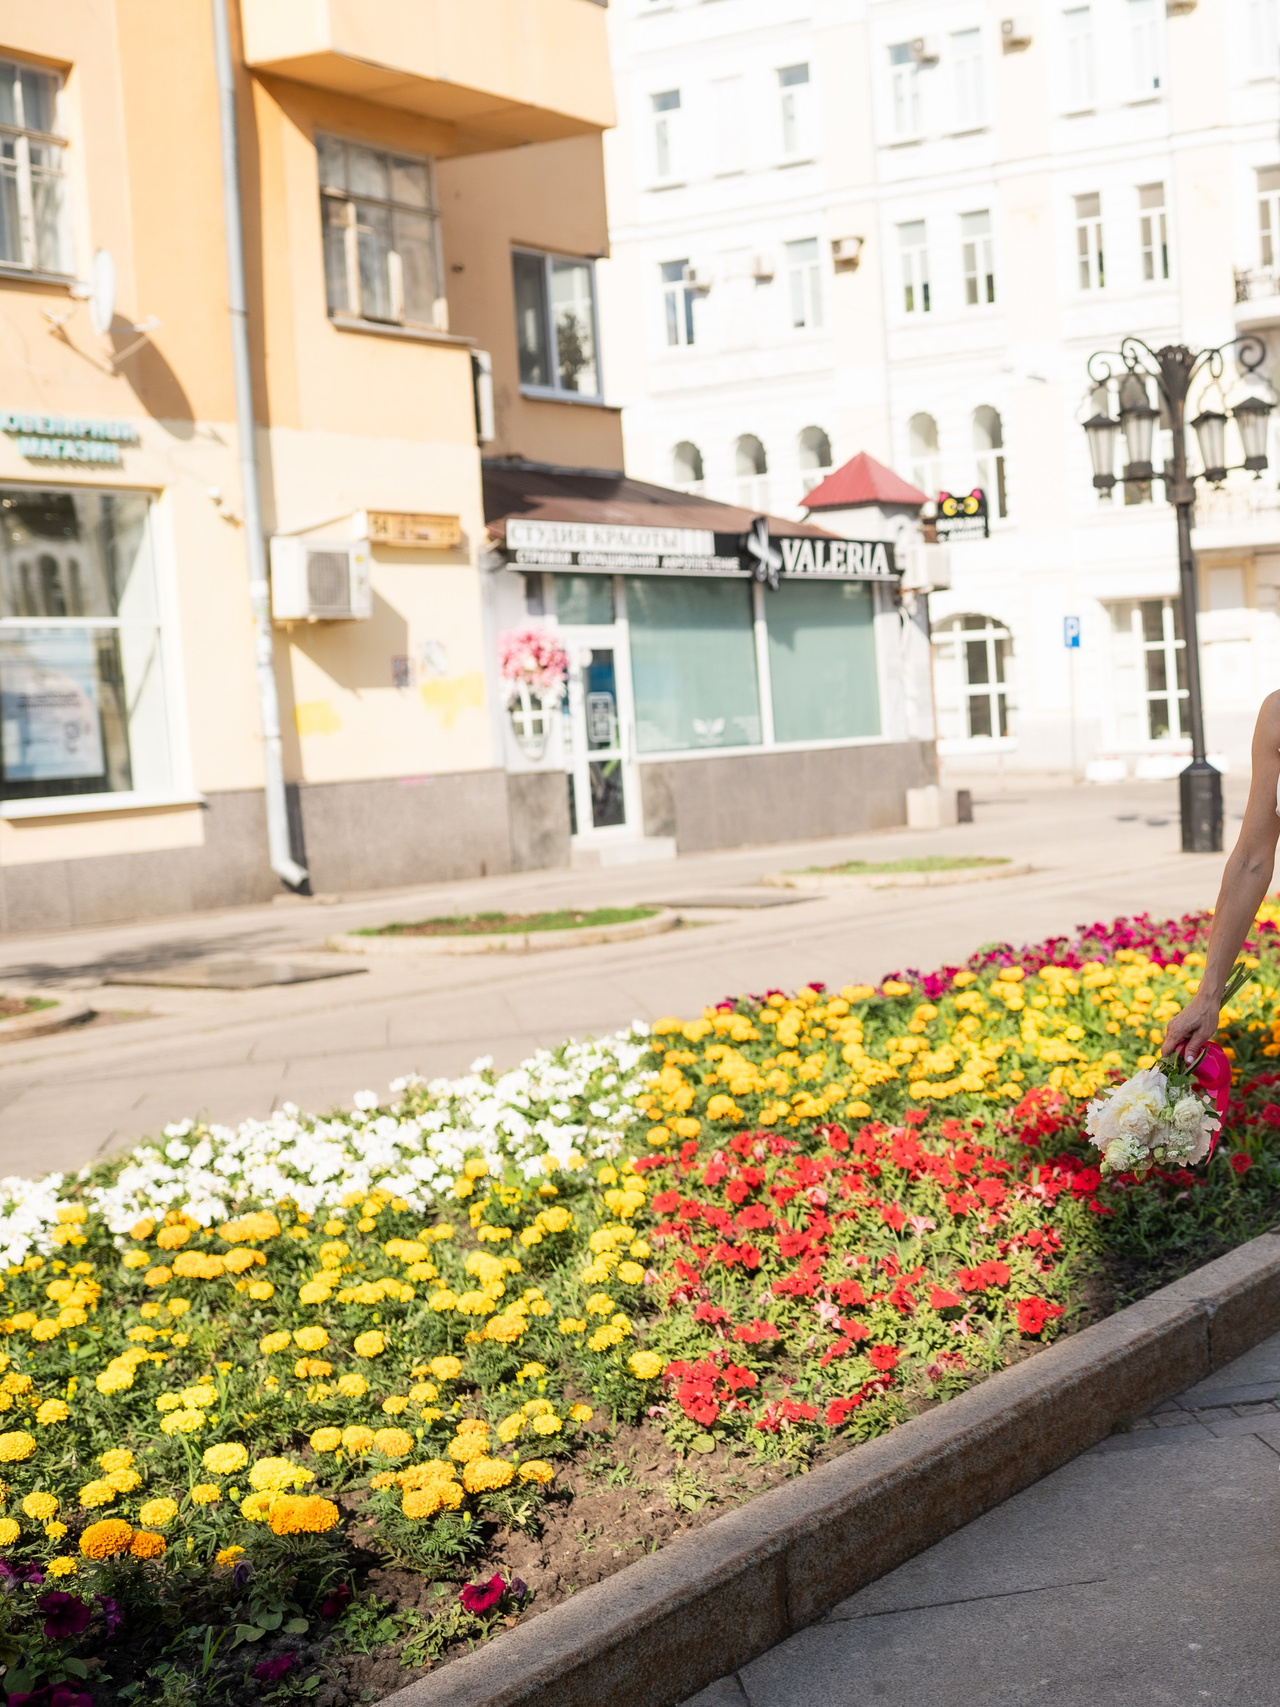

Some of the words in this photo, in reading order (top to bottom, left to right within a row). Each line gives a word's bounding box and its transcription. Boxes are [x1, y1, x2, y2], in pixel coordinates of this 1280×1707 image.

[18, 435, 120, 463] МАГАЗИН
[511, 525, 586, 546] СТУДИЯ
[593, 529, 678, 547] КРАСОТЫ
[780, 538, 890, 574] VALERIA
[1066, 618, 1079, 646] P
